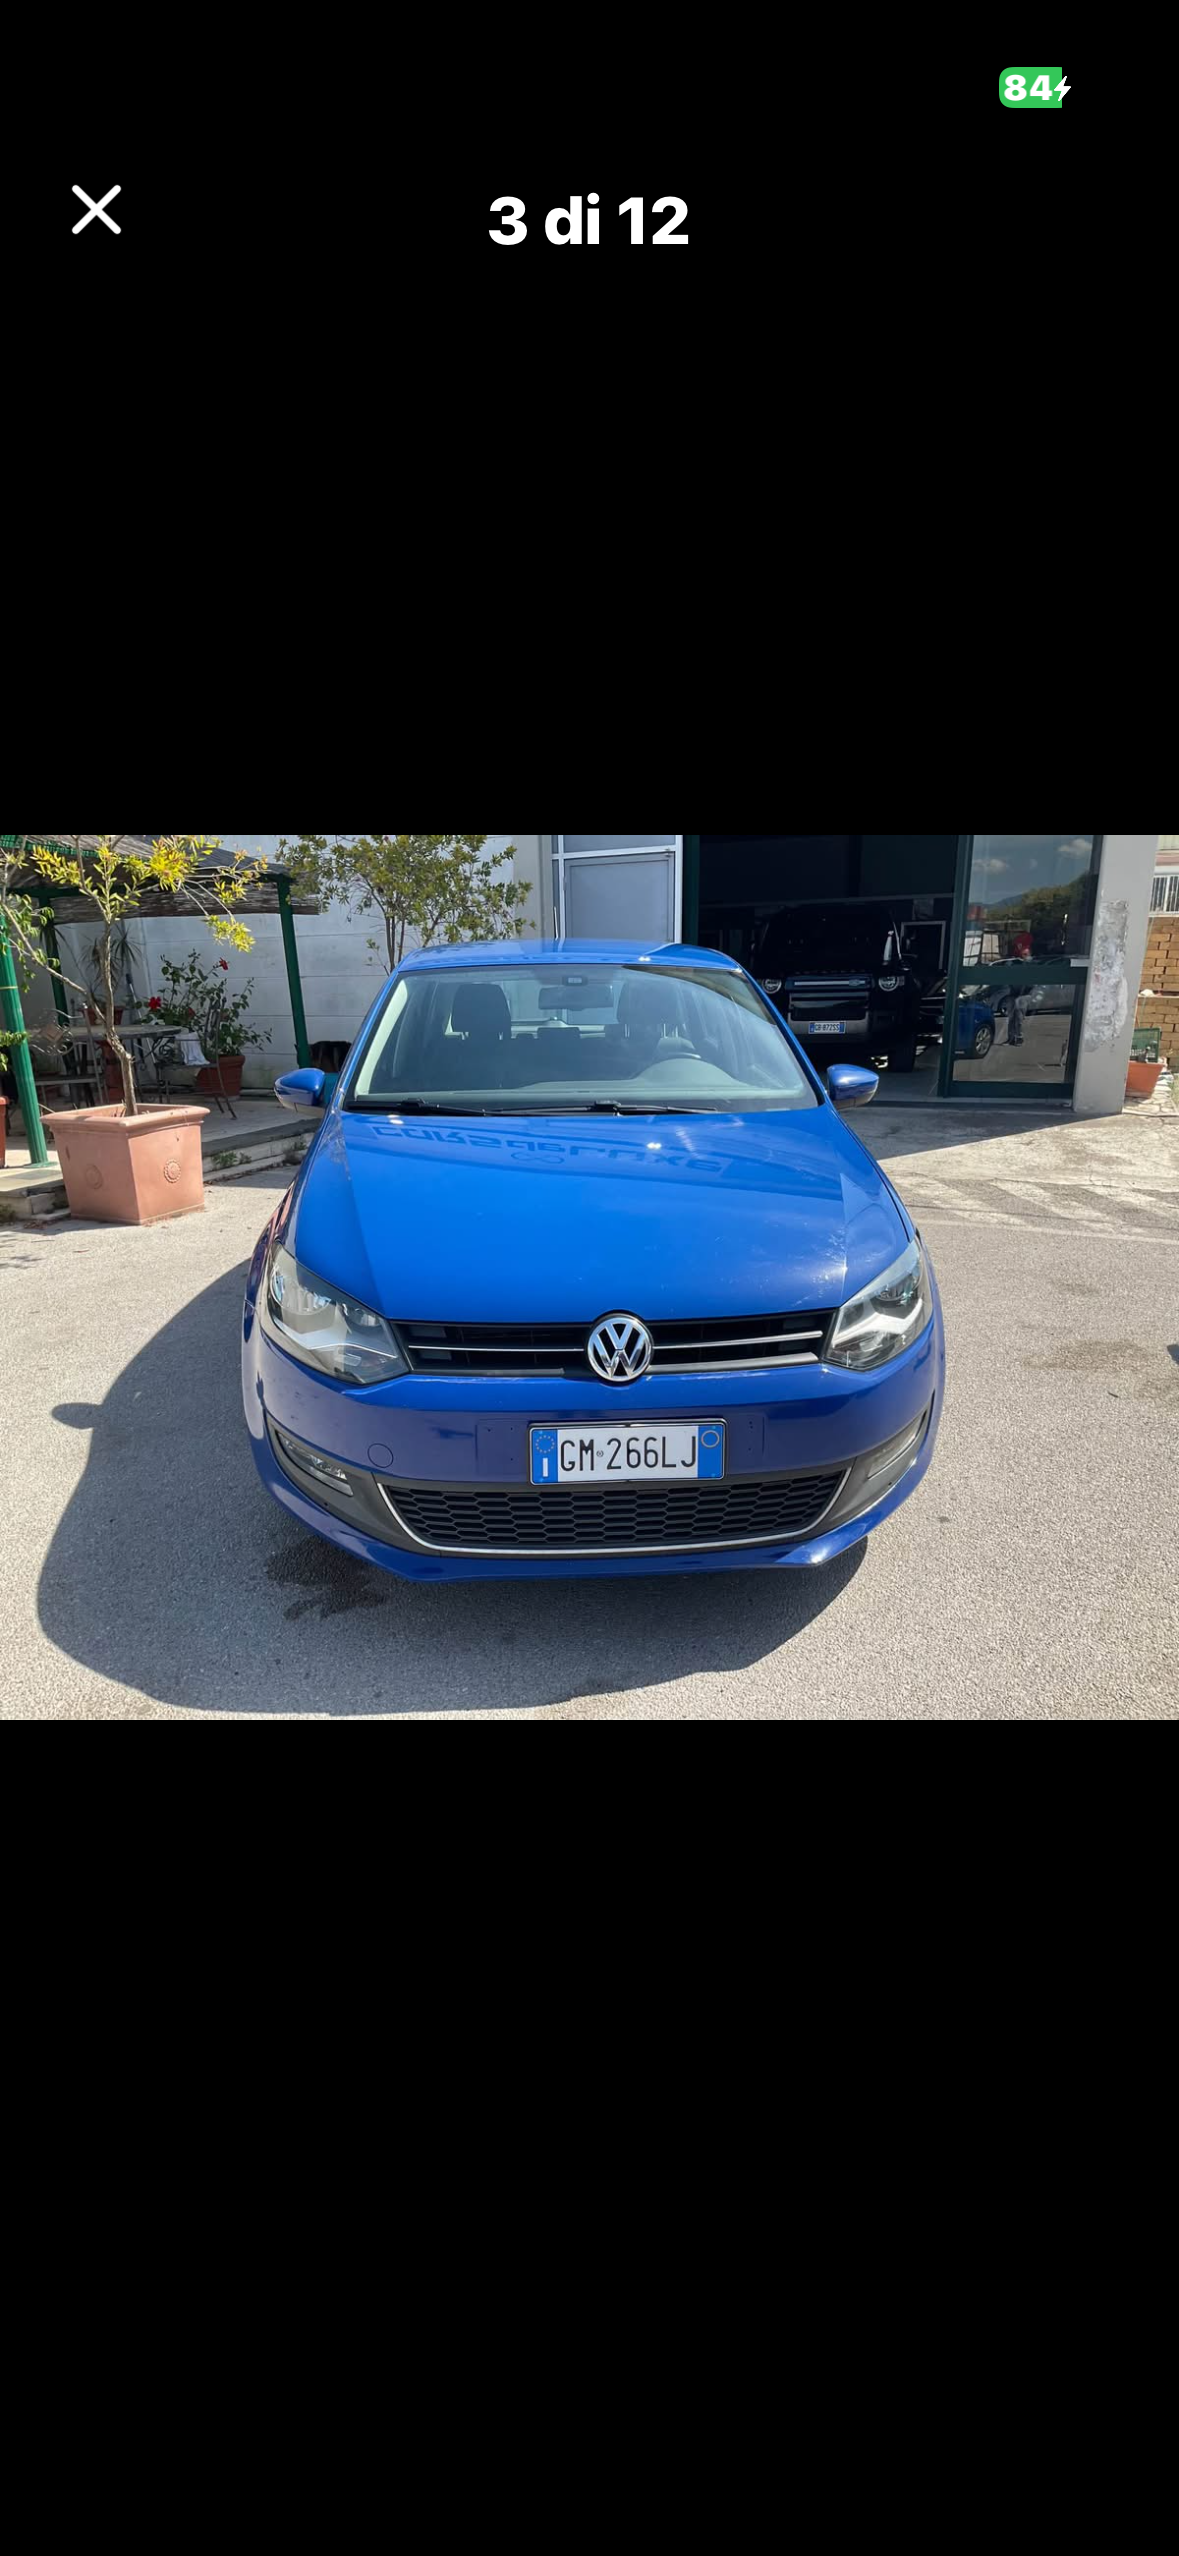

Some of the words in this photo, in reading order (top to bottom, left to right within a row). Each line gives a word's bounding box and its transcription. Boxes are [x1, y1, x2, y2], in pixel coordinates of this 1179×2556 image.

[587, 1316, 653, 1382] VW
[560, 1438, 595, 1472] GM
[606, 1435, 697, 1470] 266LJ
